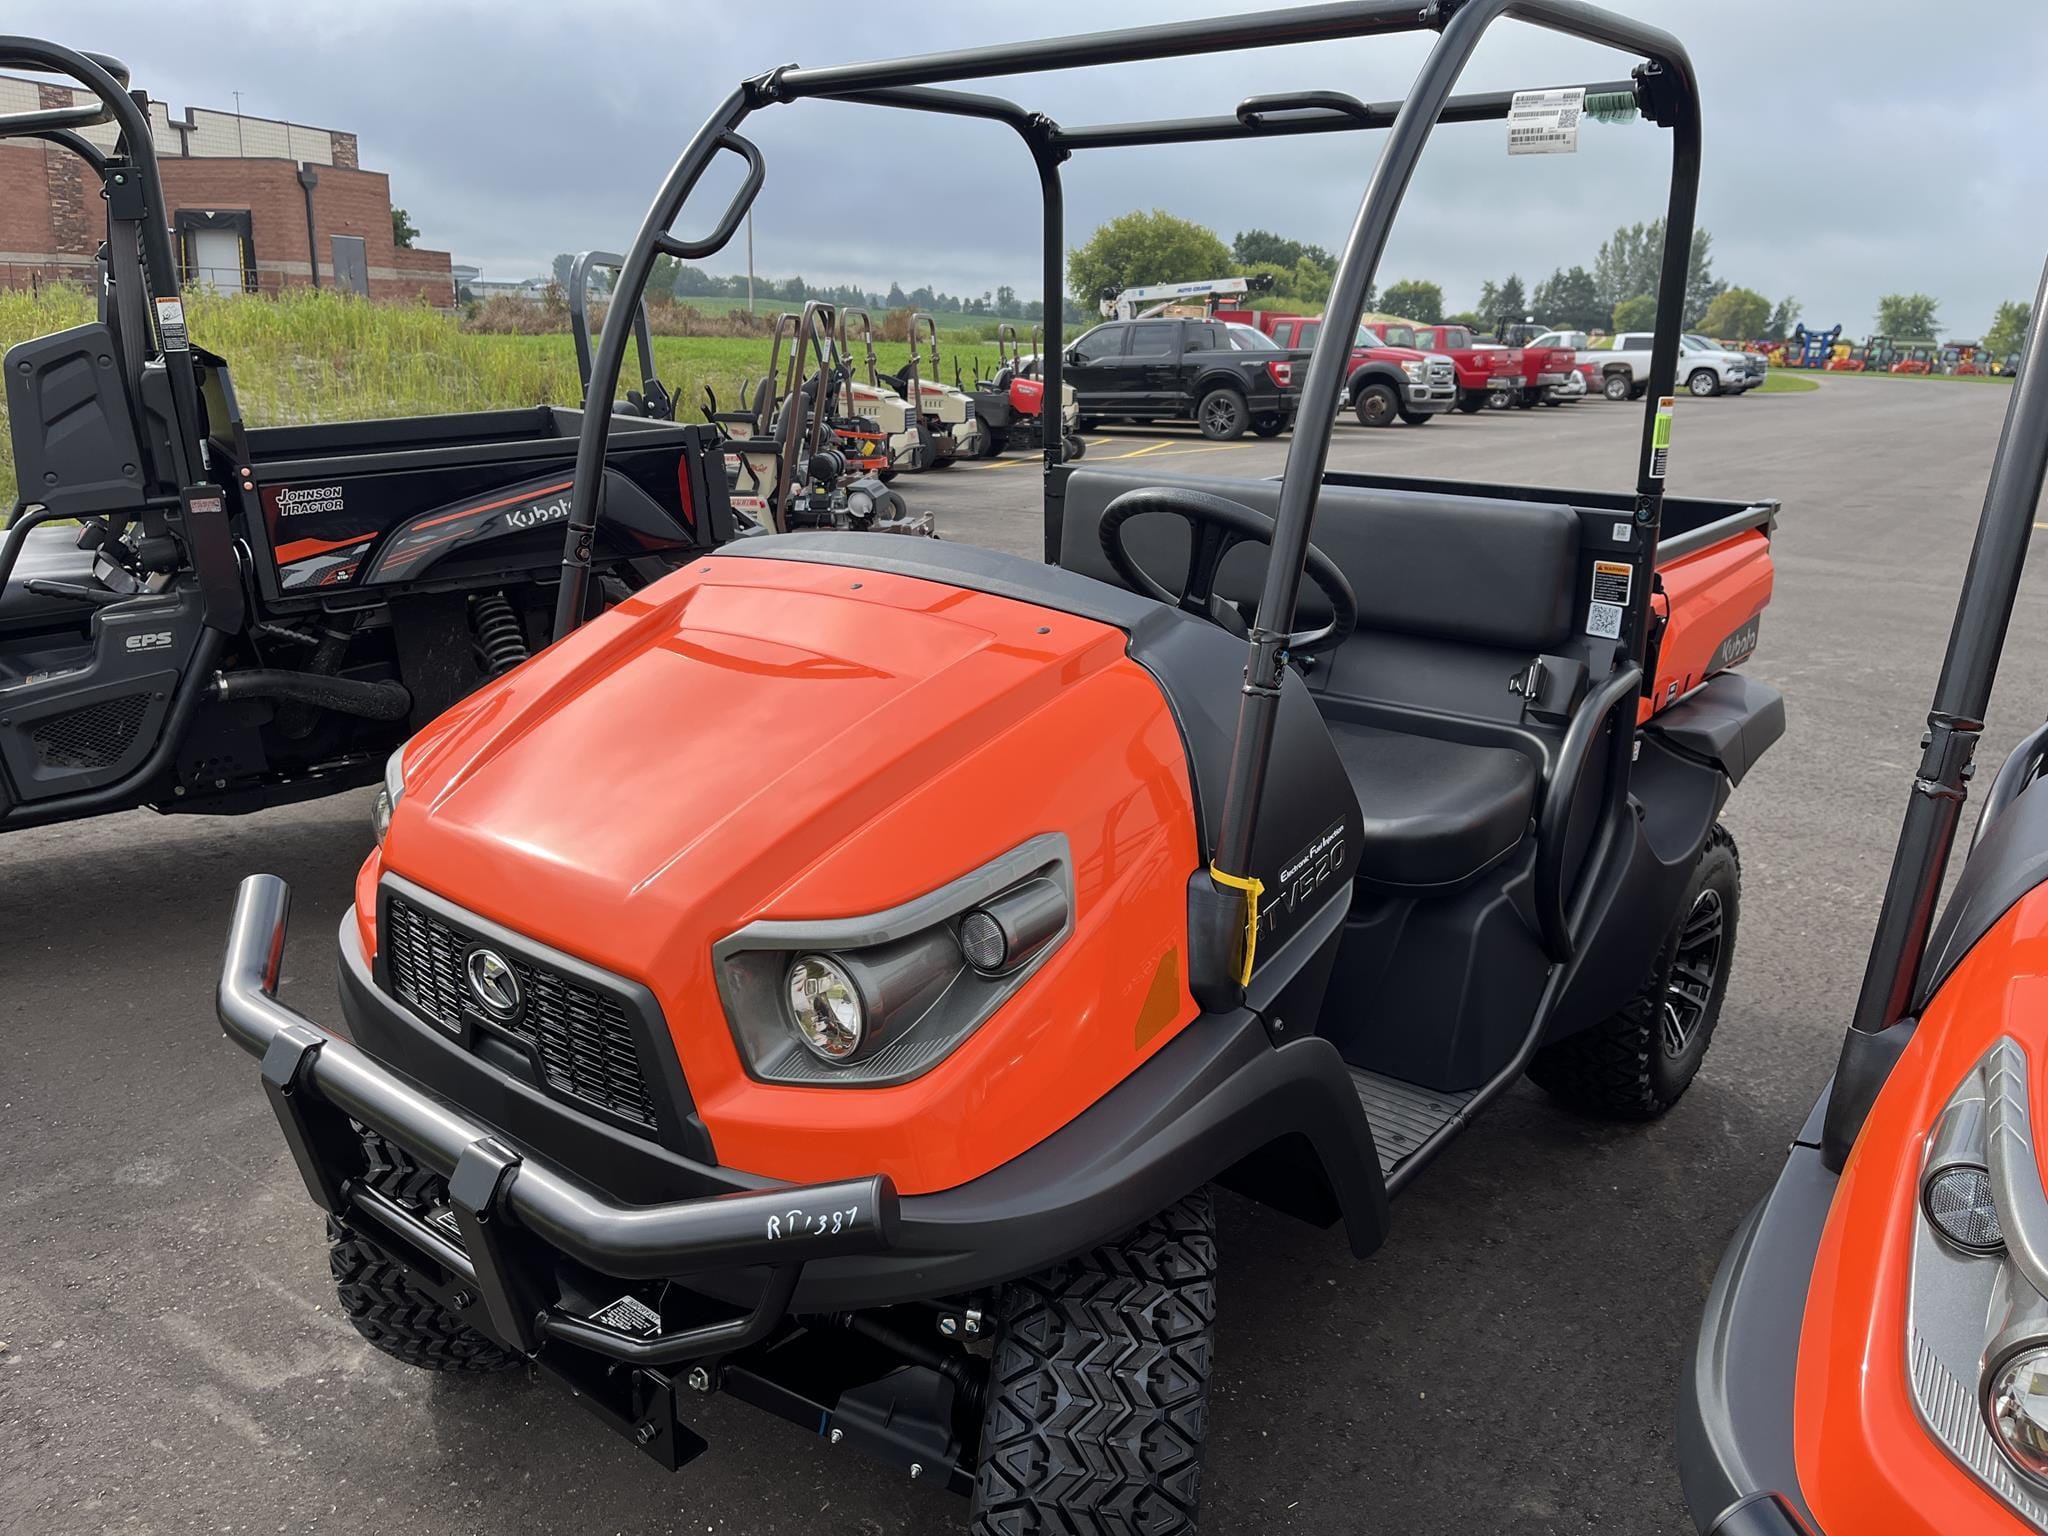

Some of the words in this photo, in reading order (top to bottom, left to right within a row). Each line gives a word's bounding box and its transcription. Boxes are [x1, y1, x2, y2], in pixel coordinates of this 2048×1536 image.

[275, 486, 342, 504] JOHNSON
[279, 499, 344, 516] TRACTOR
[126, 631, 172, 649] EPS
[1722, 628, 1757, 662] Kubota
